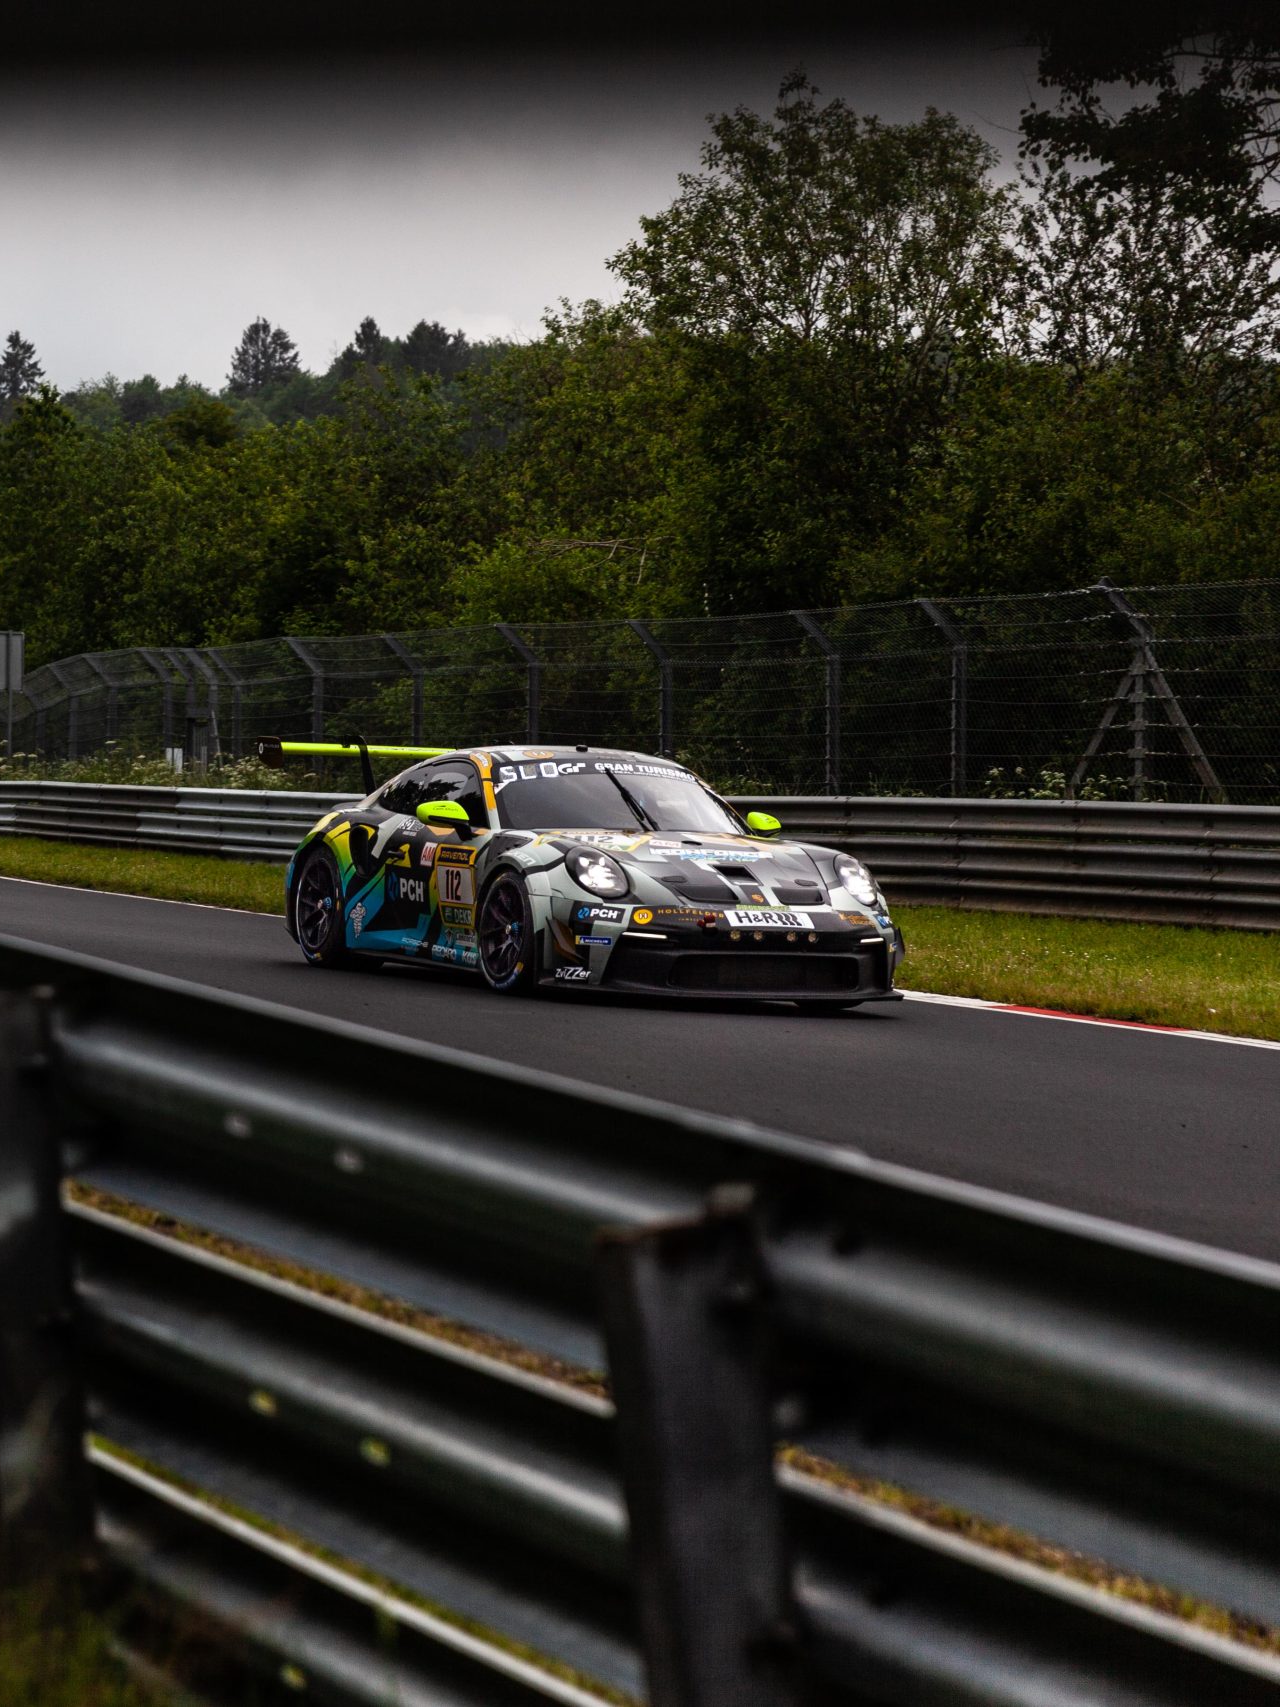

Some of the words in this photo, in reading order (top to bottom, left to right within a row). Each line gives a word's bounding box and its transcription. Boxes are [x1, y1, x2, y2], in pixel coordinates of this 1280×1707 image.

[594, 762, 633, 772] GRAN
[635, 764, 696, 782] TURISMO
[421, 846, 436, 862] AM
[441, 850, 469, 861] RAVENOL
[399, 878, 424, 902] PCH
[445, 868, 462, 901] 112
[453, 908, 472, 924] DEKR
[590, 908, 618, 919] PCH
[734, 911, 778, 924] H&R
